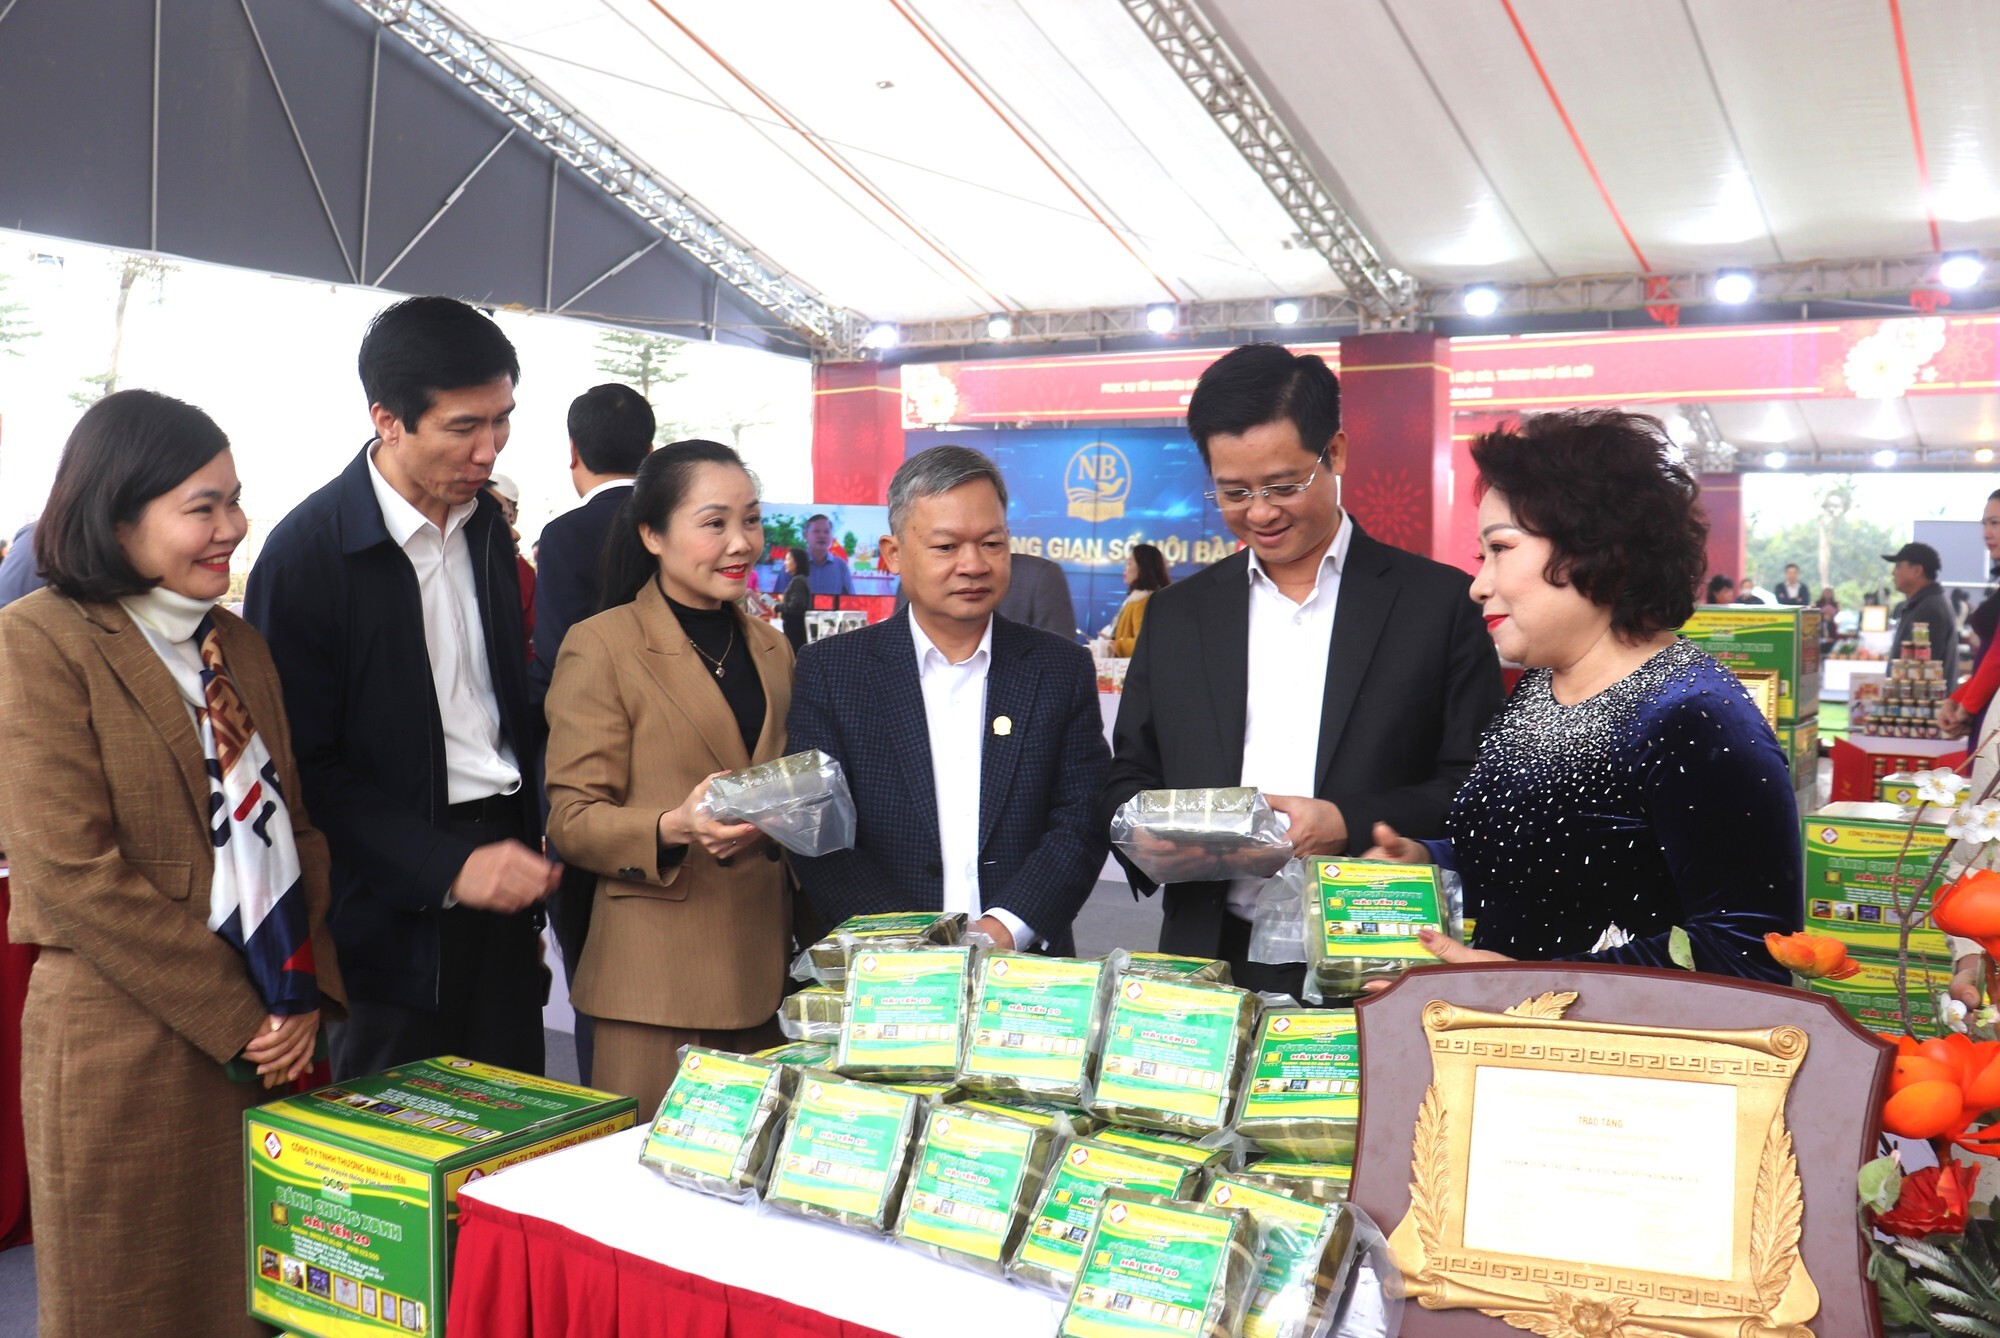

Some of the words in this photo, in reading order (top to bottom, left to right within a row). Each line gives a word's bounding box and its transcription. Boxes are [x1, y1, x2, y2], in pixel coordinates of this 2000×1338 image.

[1077, 454, 1117, 481] NB
[1047, 537, 1103, 563] GIAN
[1913, 1015, 1930, 1025] 20
[1182, 1036, 1198, 1046] 20
[1290, 1052, 1310, 1061] HẢI
[1334, 1053, 1350, 1061] 20
[1579, 1116, 1598, 1126] TRAO
[275, 1185, 313, 1212] BÁNH
[313, 1198, 362, 1228] CHƯNG
[360, 1213, 403, 1242] XANH
[302, 1213, 326, 1232] HẢI
[327, 1221, 352, 1242] YẾN
[352, 1231, 371, 1247] 20
[1119, 1257, 1141, 1270] HẢI
[1164, 1268, 1180, 1279] 20
